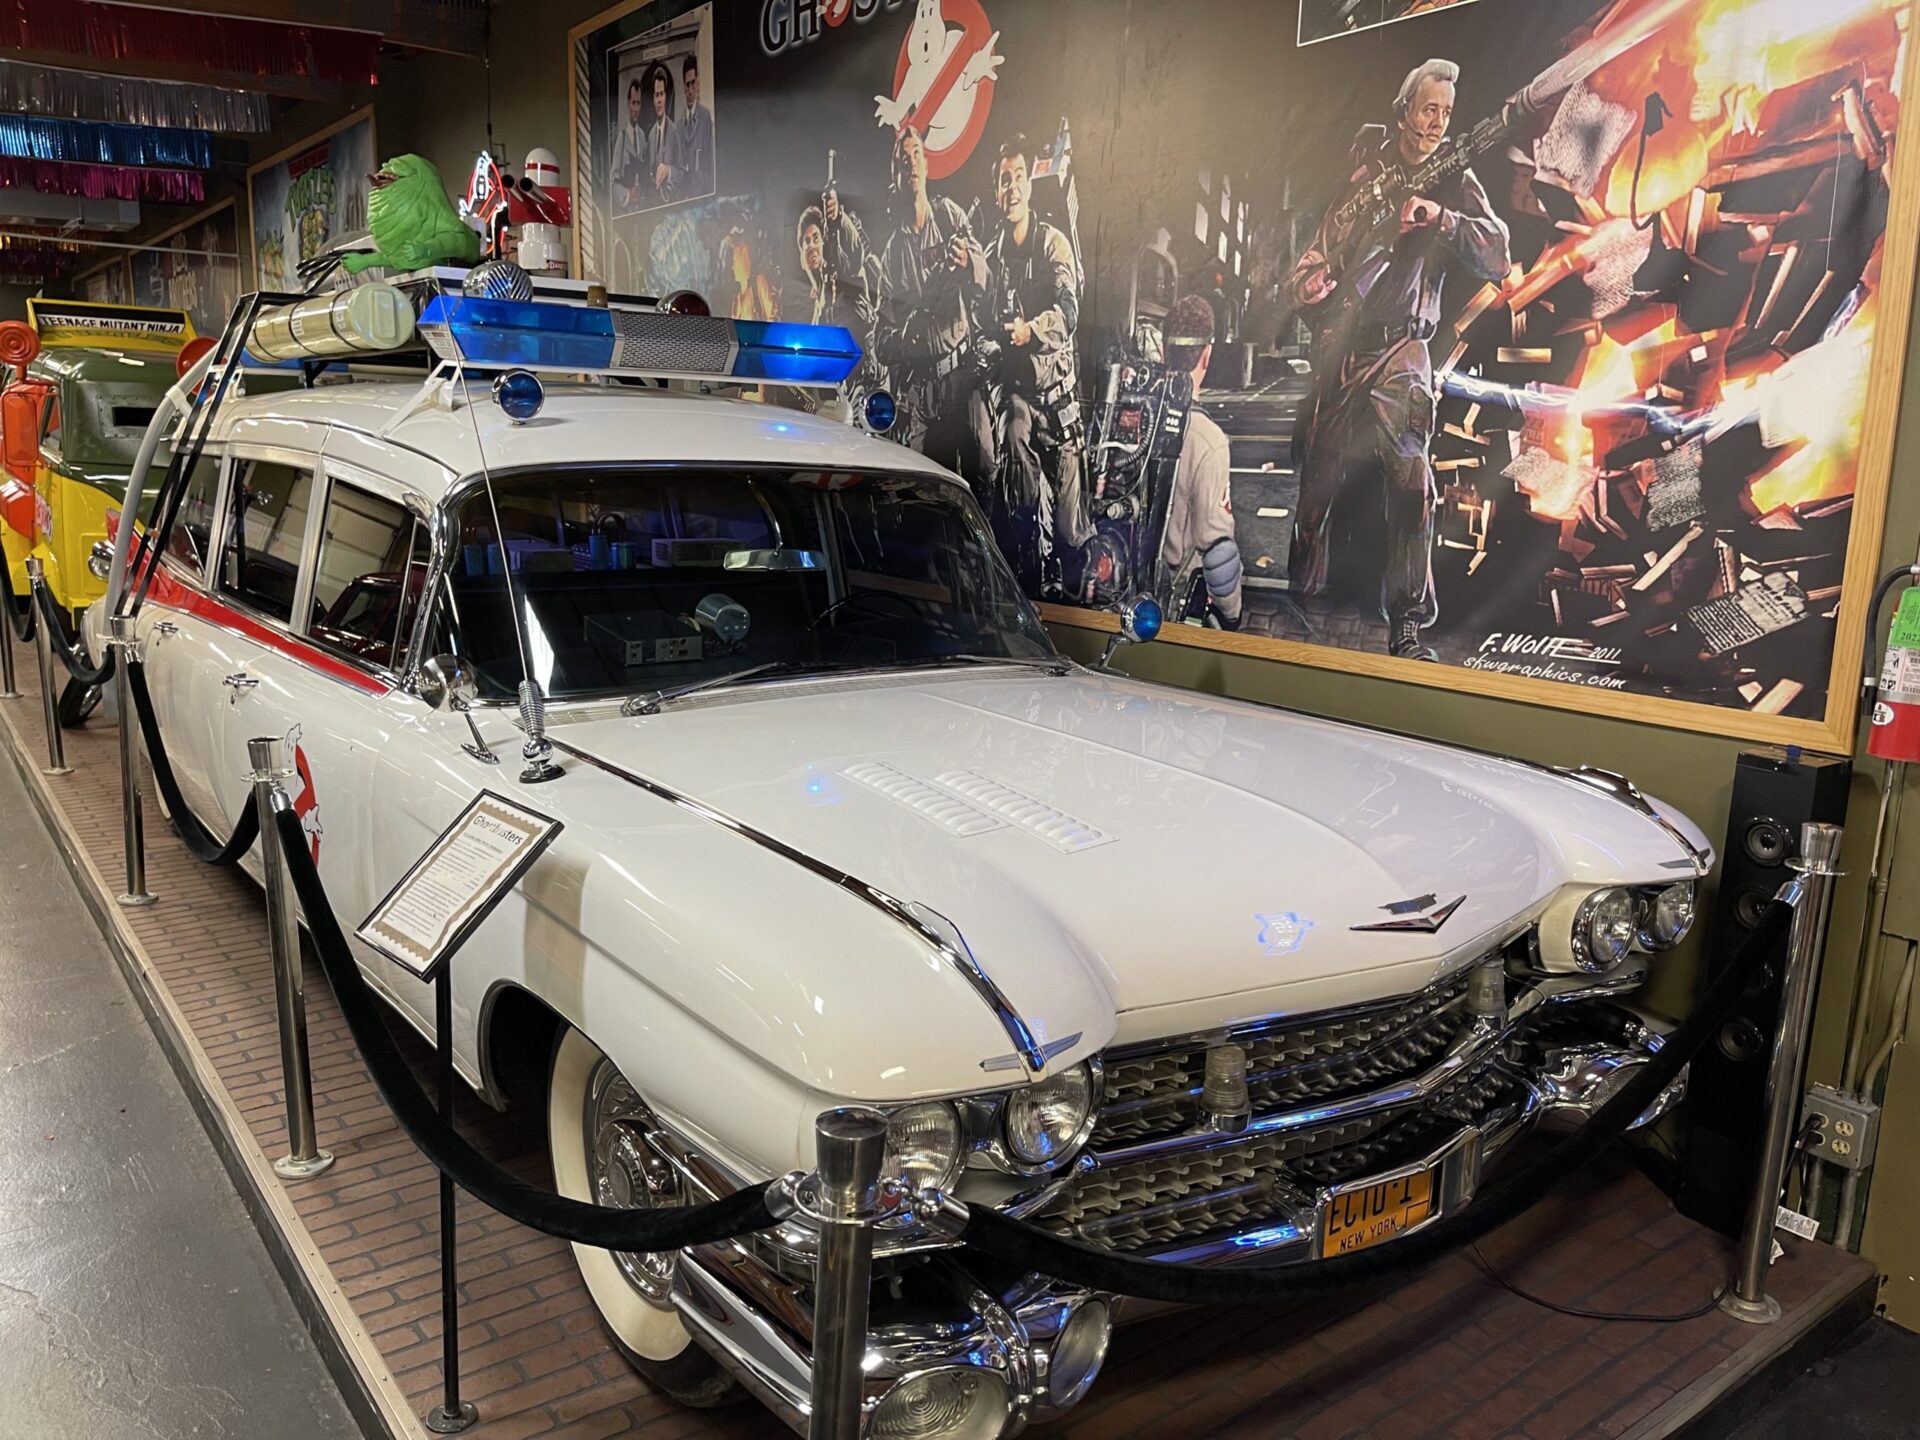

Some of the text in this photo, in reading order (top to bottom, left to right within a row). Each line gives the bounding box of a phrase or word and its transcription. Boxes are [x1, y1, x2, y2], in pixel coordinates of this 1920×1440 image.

[40, 315, 181, 334] TEENAGE MUTANT NINJA
[1588, 647, 1622, 660] 2011
[1340, 1215, 1398, 1252] NEW YORK
